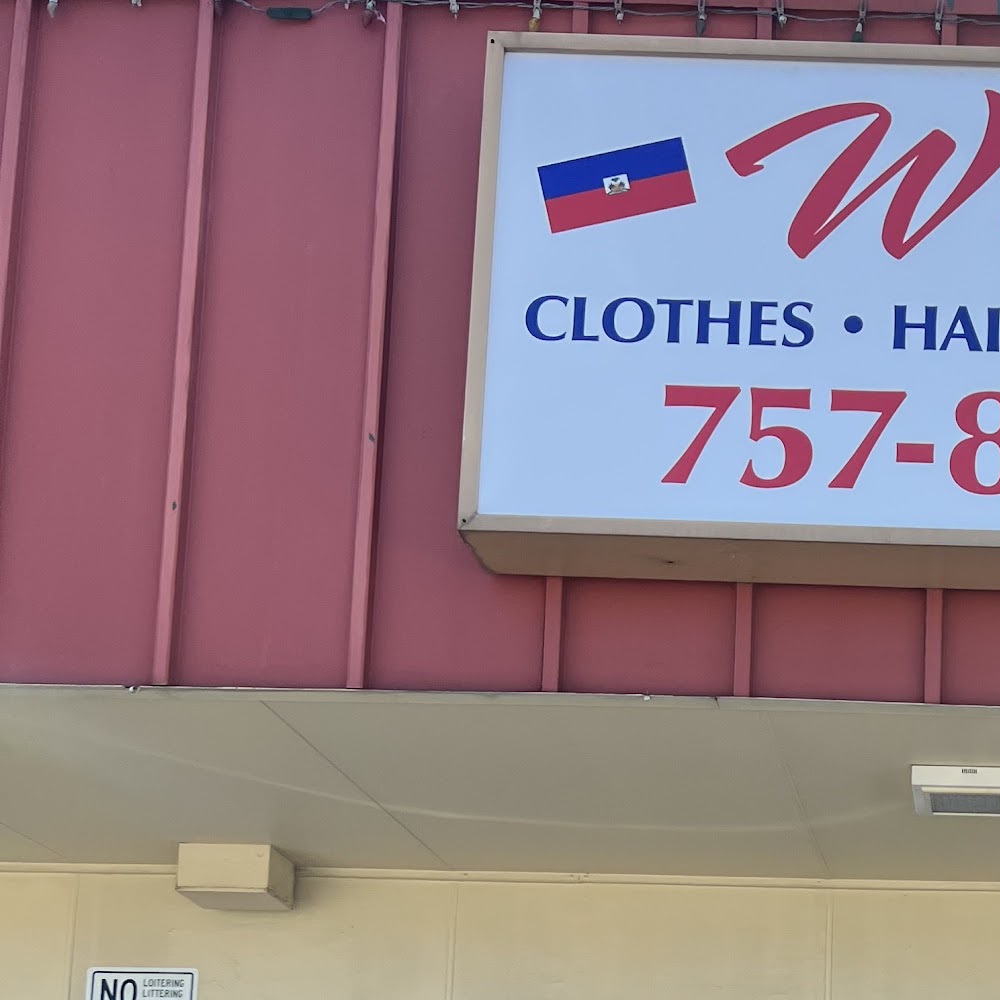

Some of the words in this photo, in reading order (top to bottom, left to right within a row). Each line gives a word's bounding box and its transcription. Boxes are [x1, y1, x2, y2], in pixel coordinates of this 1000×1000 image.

[524, 294, 815, 348] CLOTHES
[143, 979, 185, 988] LOITERING
[142, 989, 183, 998] LITTERING
